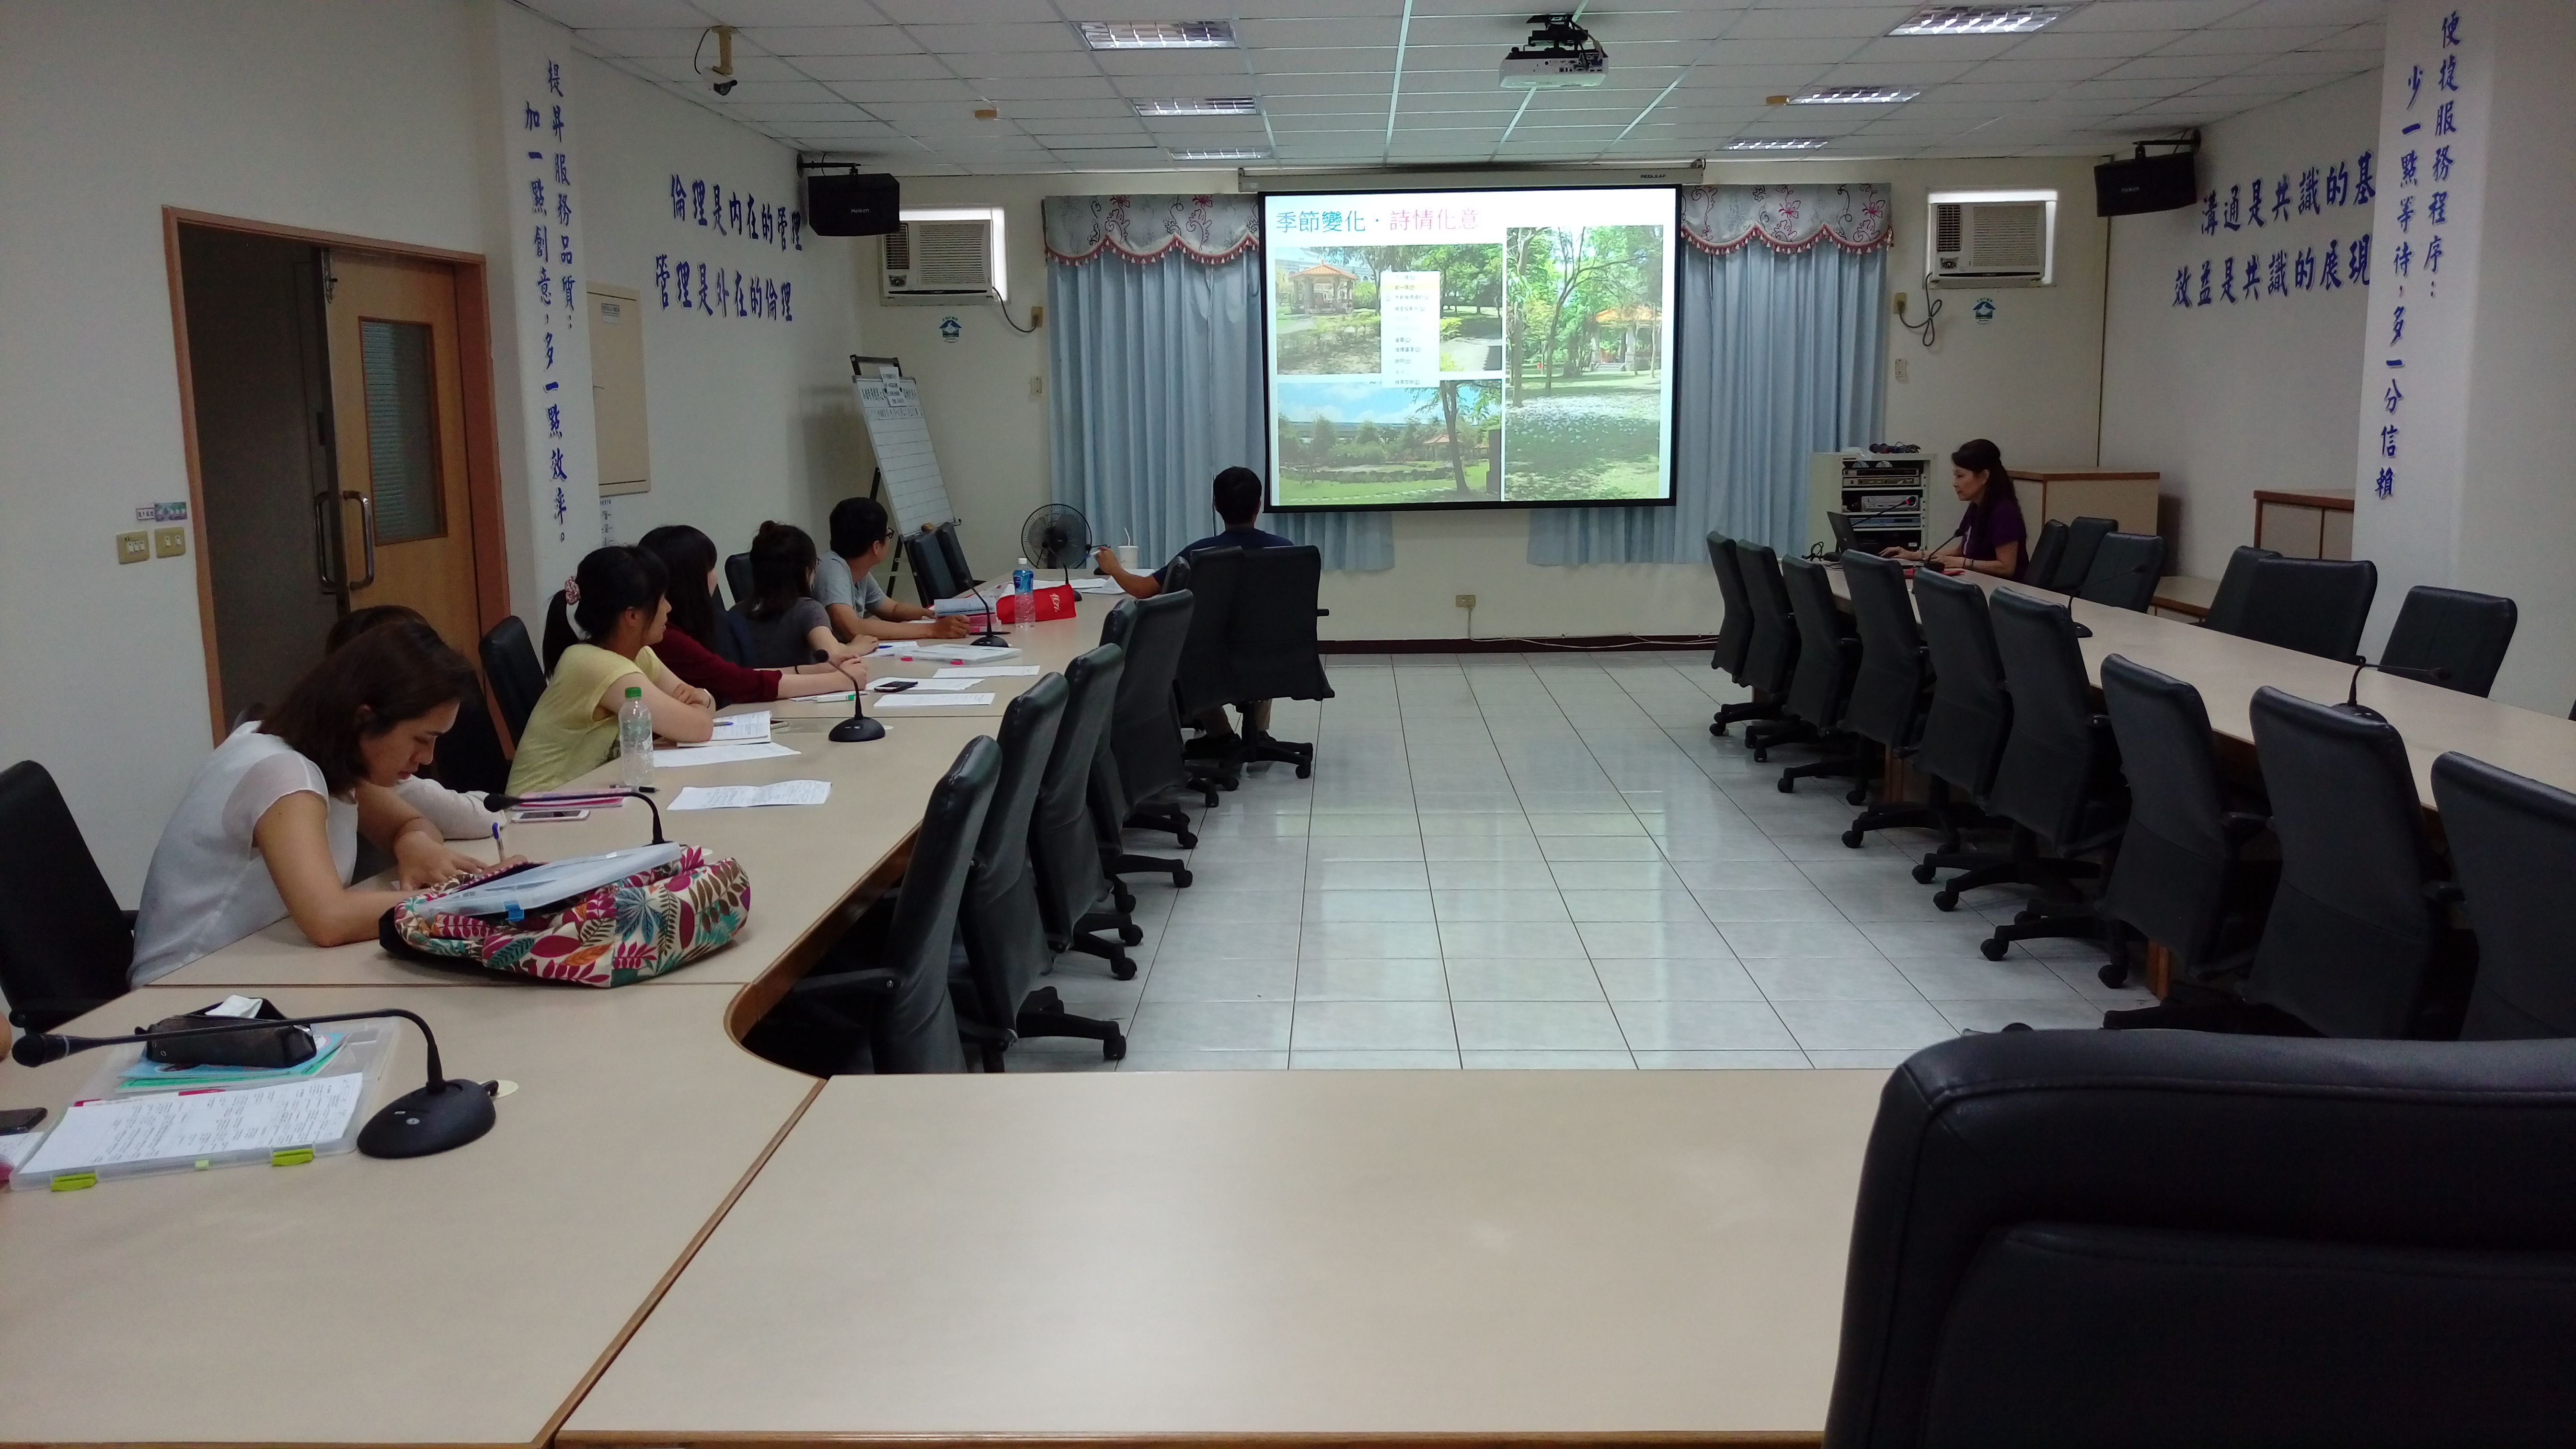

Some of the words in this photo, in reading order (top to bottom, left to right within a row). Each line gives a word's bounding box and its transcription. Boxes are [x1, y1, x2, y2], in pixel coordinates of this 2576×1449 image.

[670, 174, 803, 252] 倫理是內在的管理
[2200, 149, 2376, 236] 溝通是共識的基
[655, 254, 793, 322] 管理是外在的倫理
[2172, 234, 2370, 308] 效益是共識的展現
